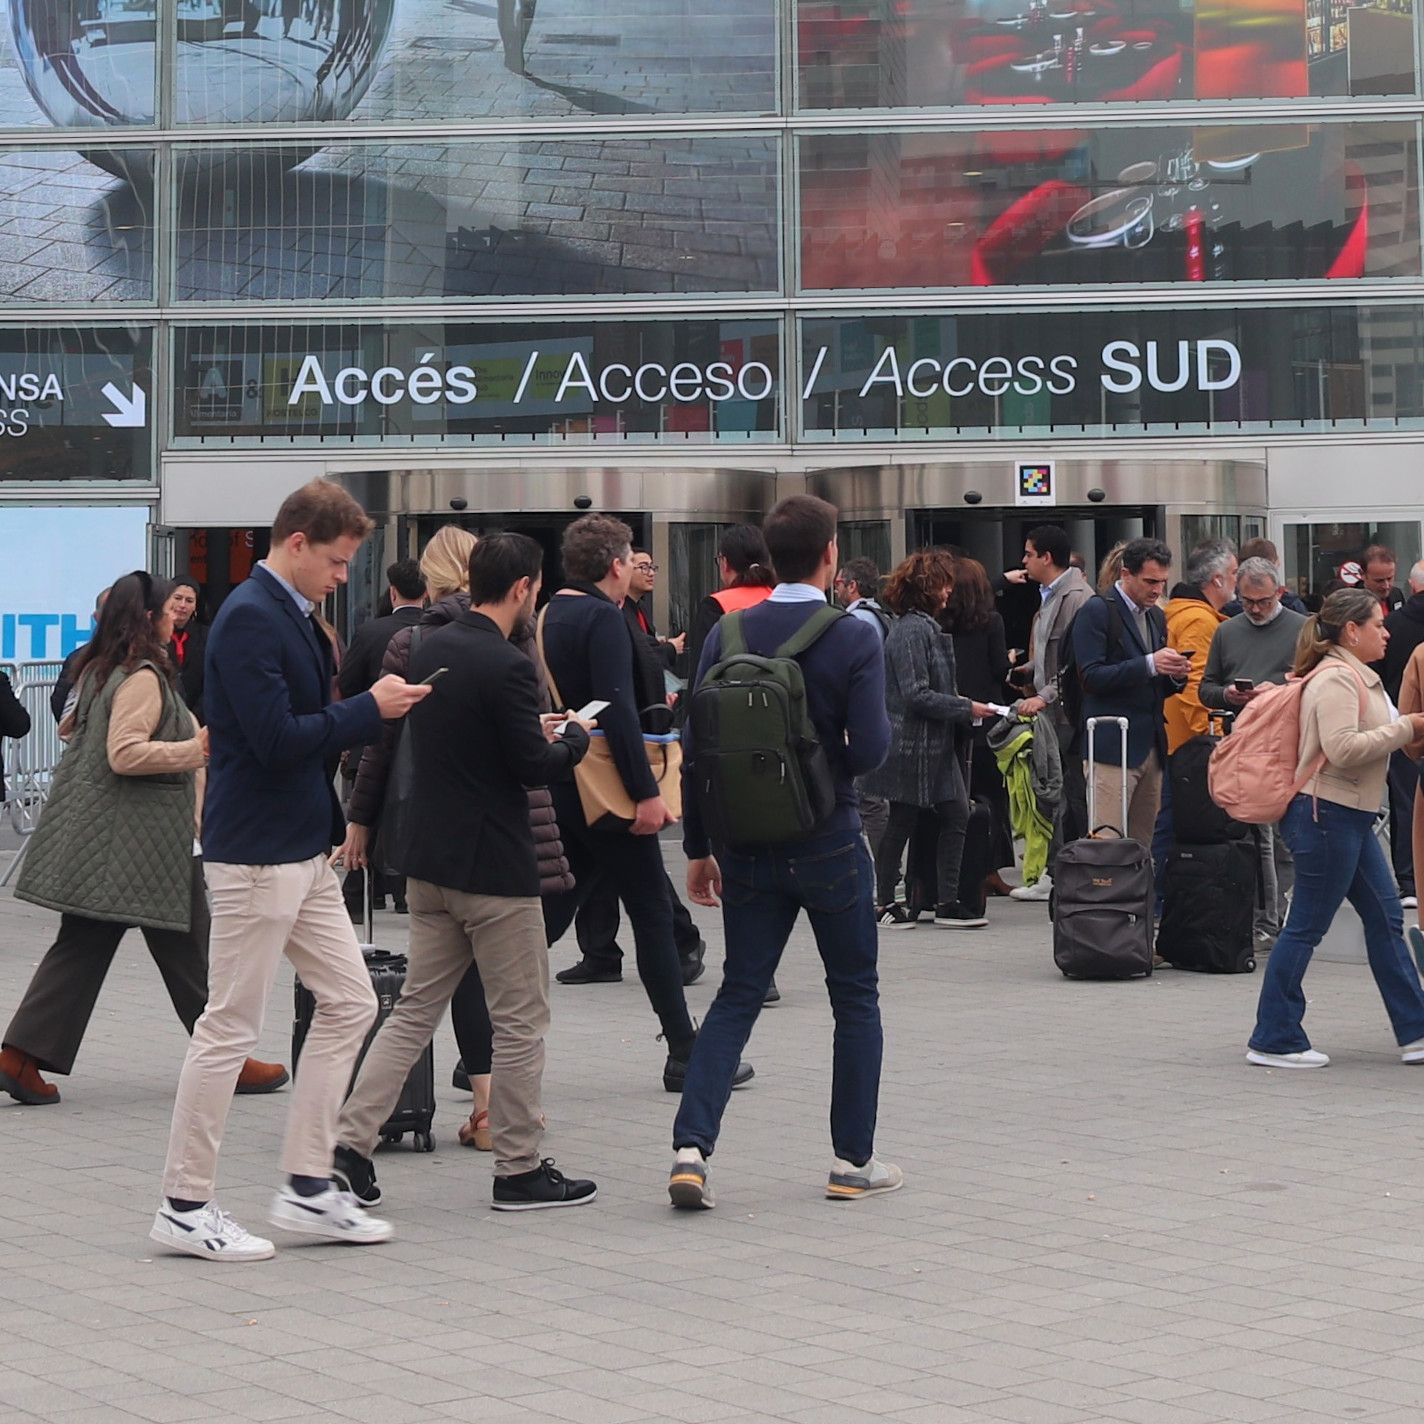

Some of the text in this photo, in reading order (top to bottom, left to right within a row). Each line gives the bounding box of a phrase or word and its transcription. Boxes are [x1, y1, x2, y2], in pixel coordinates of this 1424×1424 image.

[289, 353, 476, 405] Accés
[514, 351, 539, 404] /
[555, 351, 773, 403] Acceso
[802, 346, 828, 400] /
[859, 345, 1077, 397] Access
[1101, 339, 1241, 393] SUD
